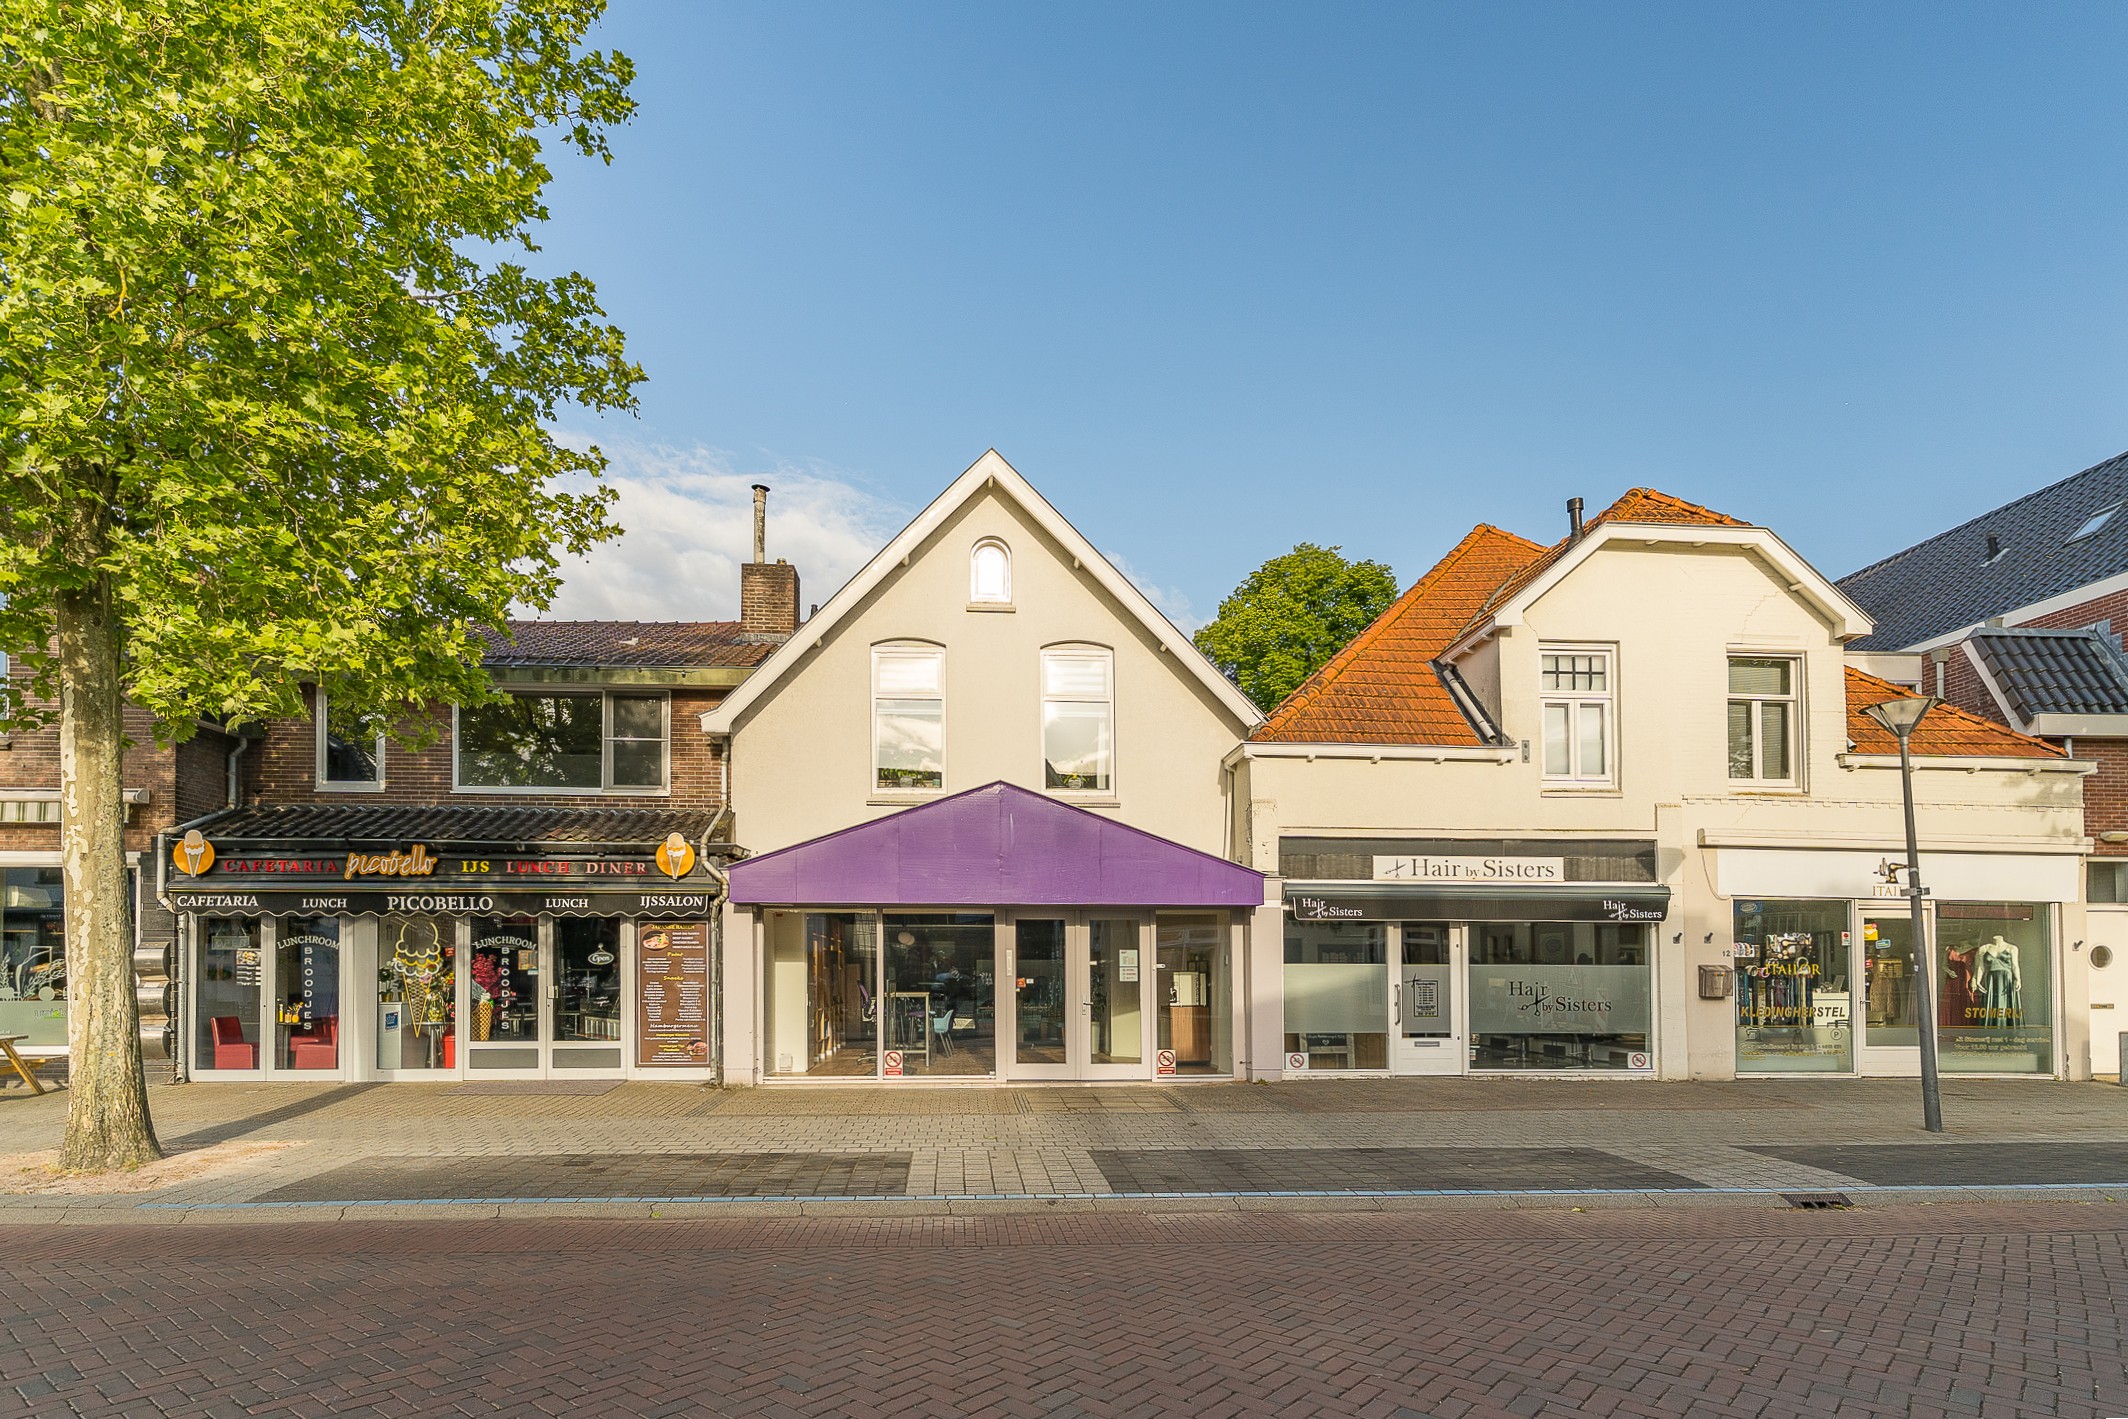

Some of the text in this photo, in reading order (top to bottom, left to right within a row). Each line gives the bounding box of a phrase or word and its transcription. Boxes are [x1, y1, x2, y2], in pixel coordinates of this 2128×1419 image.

[223, 859, 338, 873] CAFETARIA
[344, 844, 438, 880] picobello
[461, 860, 647, 875] IJS LUNCH DINER
[1411, 858, 1555, 879] Hair by Sisters
[176, 895, 259, 907] CAFETARIA
[302, 898, 348, 909] LUNCH
[387, 896, 494, 911] PICOBELLO
[545, 898, 589, 909] LUNCH
[640, 895, 704, 908] IJSSALON
[1302, 898, 1326, 910] Hair
[1603, 900, 1626, 911] Hair
[1329, 907, 1363, 917] Sisters
[1629, 909, 1663, 918] Sisters
[277, 936, 340, 950] LUNCHROOM
[475, 936, 538, 950] LUNCHROOM
[592, 954, 610, 963] Open
[1765, 963, 1821, 975] ITAILOR
[304, 947, 314, 1030] BROODJES
[501, 946, 511, 1030] BROODJES
[1509, 981, 1548, 997] Hair
[1542, 996, 1612, 1013] by Sisters
[1741, 1006, 1846, 1018] KLEDINGHERSTEL
[1964, 1007, 2023, 1019] STOMERIJ
